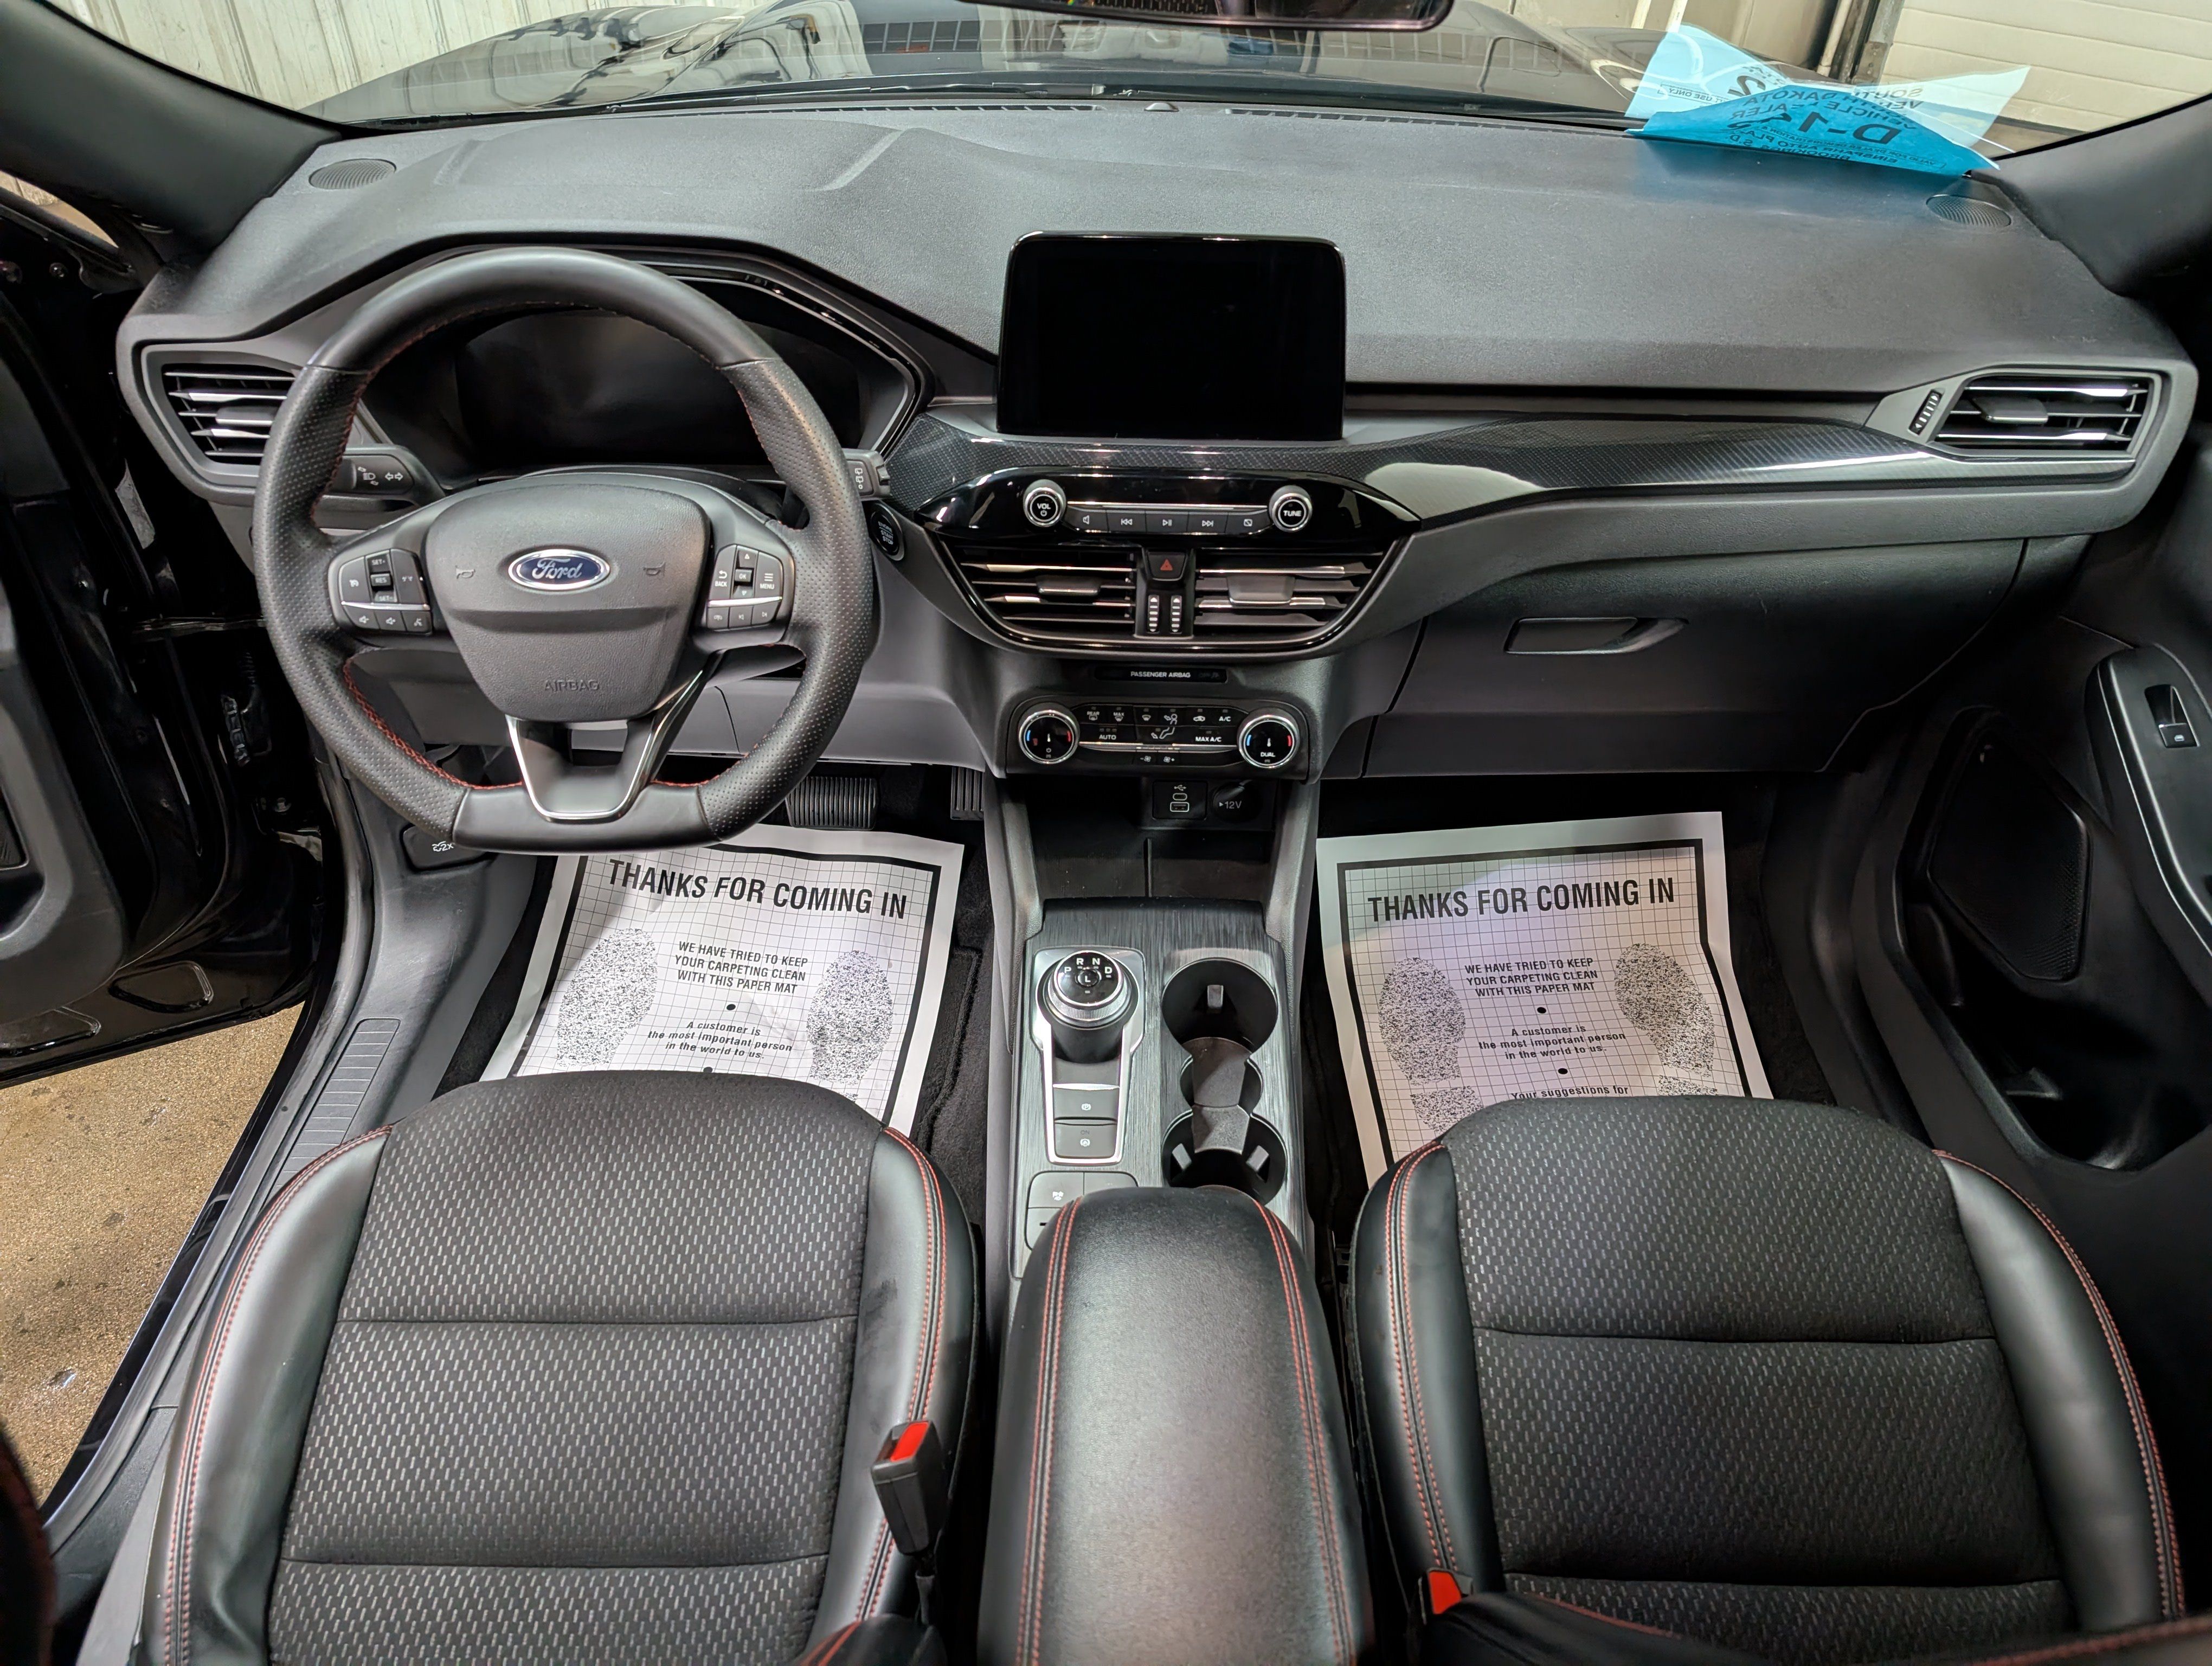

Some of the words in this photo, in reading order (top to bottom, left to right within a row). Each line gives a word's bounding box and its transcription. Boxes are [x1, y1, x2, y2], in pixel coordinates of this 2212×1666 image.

[532, 557, 583, 579] Ford
[544, 680, 600, 691] AIRBAG
[1224, 801, 1242, 809] 12V
[609, 858, 708, 898] THANKS
[713, 876, 766, 904] FOR
[773, 883, 872, 914] COMING
[880, 892, 907, 919] IN
[1367, 890, 1469, 922] THANKS
[1477, 887, 1528, 915] FOR
[1536, 879, 1639, 911] COMING
[1649, 877, 1674, 904] IN
[679, 941, 696, 953] WE
[698, 944, 727, 958] HAVE
[730, 949, 761, 962] TRIED
[764, 953, 779, 965] TO
[781, 956, 808, 967] KEEP
[674, 954, 705, 969] YOUR
[708, 960, 768, 977] CARPETING
[771, 969, 806, 981] CLEAN
[1464, 964, 1482, 974] WE
[1484, 963, 1513, 973] HAVE
[1515, 960, 1546, 971] TRIED
[1549, 959, 1564, 969] TO
[1567, 958, 1593, 967] KEEP
[678, 969, 706, 983] WITH
[709, 974, 733, 987] THIS
[736, 978, 771, 991] PAPER
[774, 982, 798, 994] MAT
[1466, 977, 1497, 986] YOUR
[1500, 972, 1560, 984] CARPETING
[1563, 970, 1598, 981] CLEAN
[1475, 987, 1504, 997] WITH
[1506, 985, 1532, 995] THIS
[1535, 983, 1570, 994] PAPER
[1572, 982, 1595, 991] MAT
[697, 1022, 748, 1034] customer
[751, 1027, 761, 1036] is
[1511, 1028, 1519, 1036] A
[1522, 1027, 1572, 1036] customer
[1576, 1024, 1586, 1033] is
[648, 1030, 665, 1039] the
[668, 1031, 695, 1040] most
[698, 1032, 752, 1047] important
[754, 1041, 793, 1052] person
[1478, 1041, 1496, 1049] the
[1500, 1040, 1528, 1048] most
[1531, 1035, 1585, 1048] important
[1587, 1032, 1626, 1043] person
[665, 1041, 676, 1050] in
[679, 1042, 696, 1052] the
[700, 1044, 731, 1055] world
[734, 1047, 745, 1056] to
[748, 1051, 764, 1059] us.
[1504, 1051, 1515, 1060] in
[1519, 1050, 1537, 1059] the
[1540, 1047, 1572, 1057] world
[1574, 1046, 1586, 1054] to
[1589, 1045, 1607, 1053] us.
[1511, 1091, 1537, 1099] Your
[1541, 1086, 1610, 1097] suggestions
[1612, 1085, 1629, 1094] for
